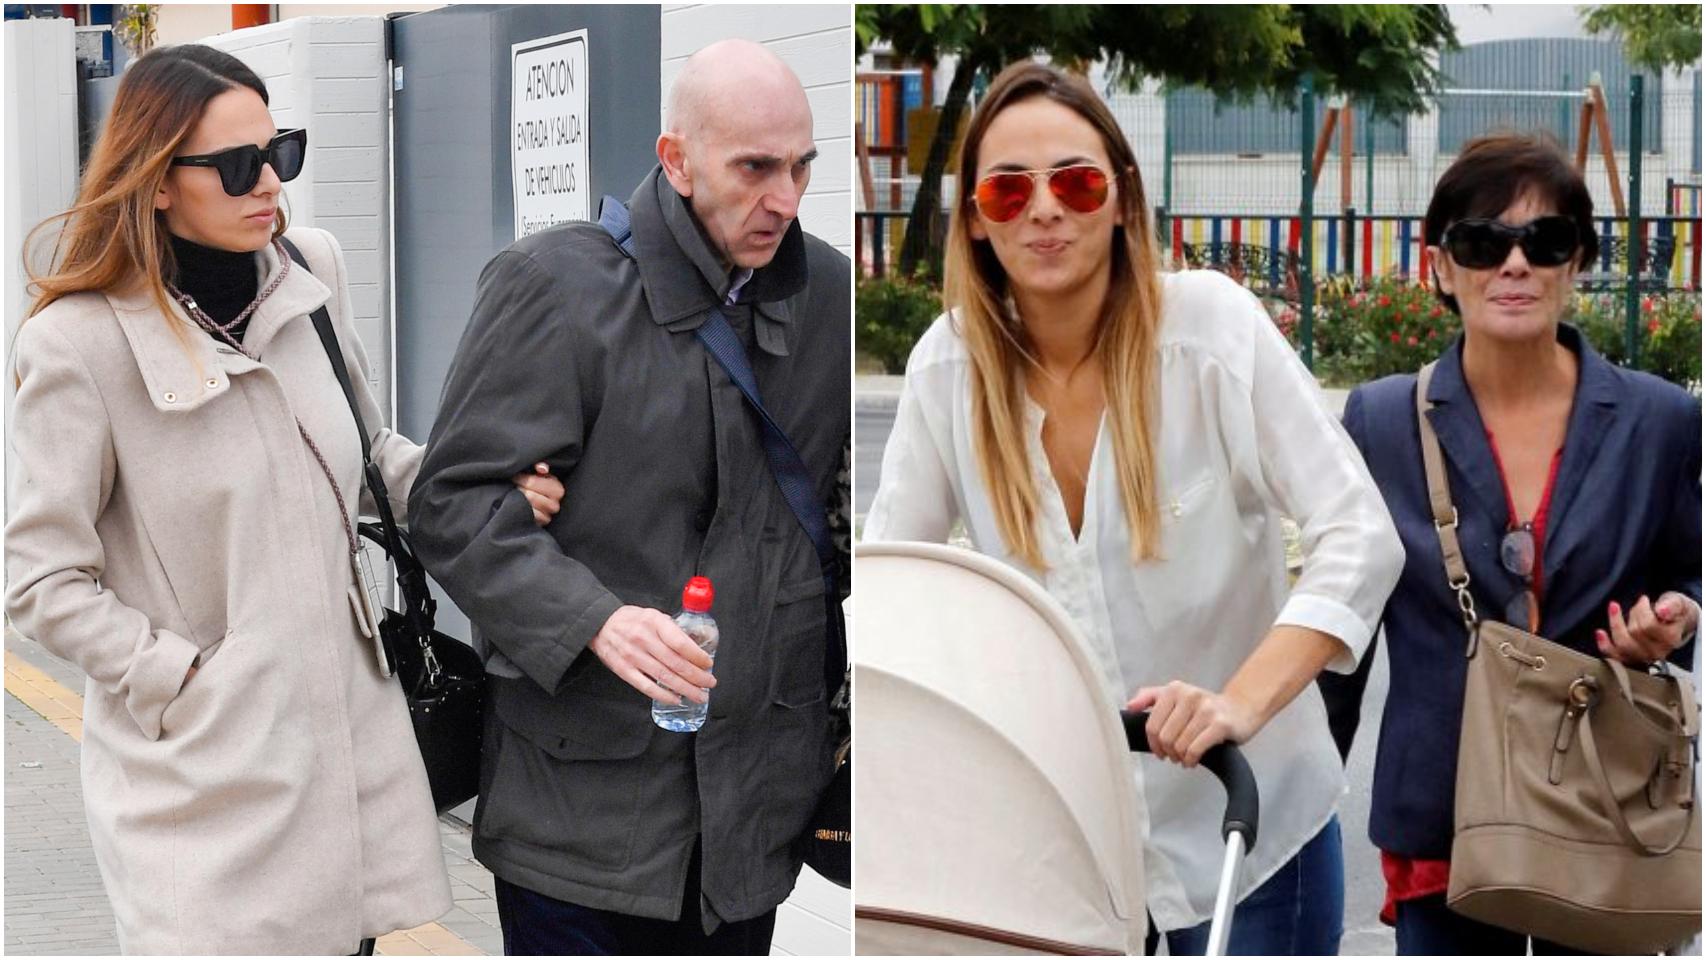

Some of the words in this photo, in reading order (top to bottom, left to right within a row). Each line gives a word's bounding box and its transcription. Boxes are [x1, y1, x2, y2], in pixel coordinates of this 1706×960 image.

[525, 58, 574, 102] ATENCION
[517, 118, 549, 151] ENTRADA
[549, 116, 556, 148] Y
[556, 113, 582, 147] SALIDA
[525, 167, 536, 196] DE
[535, 162, 576, 195] VEHICULOS
